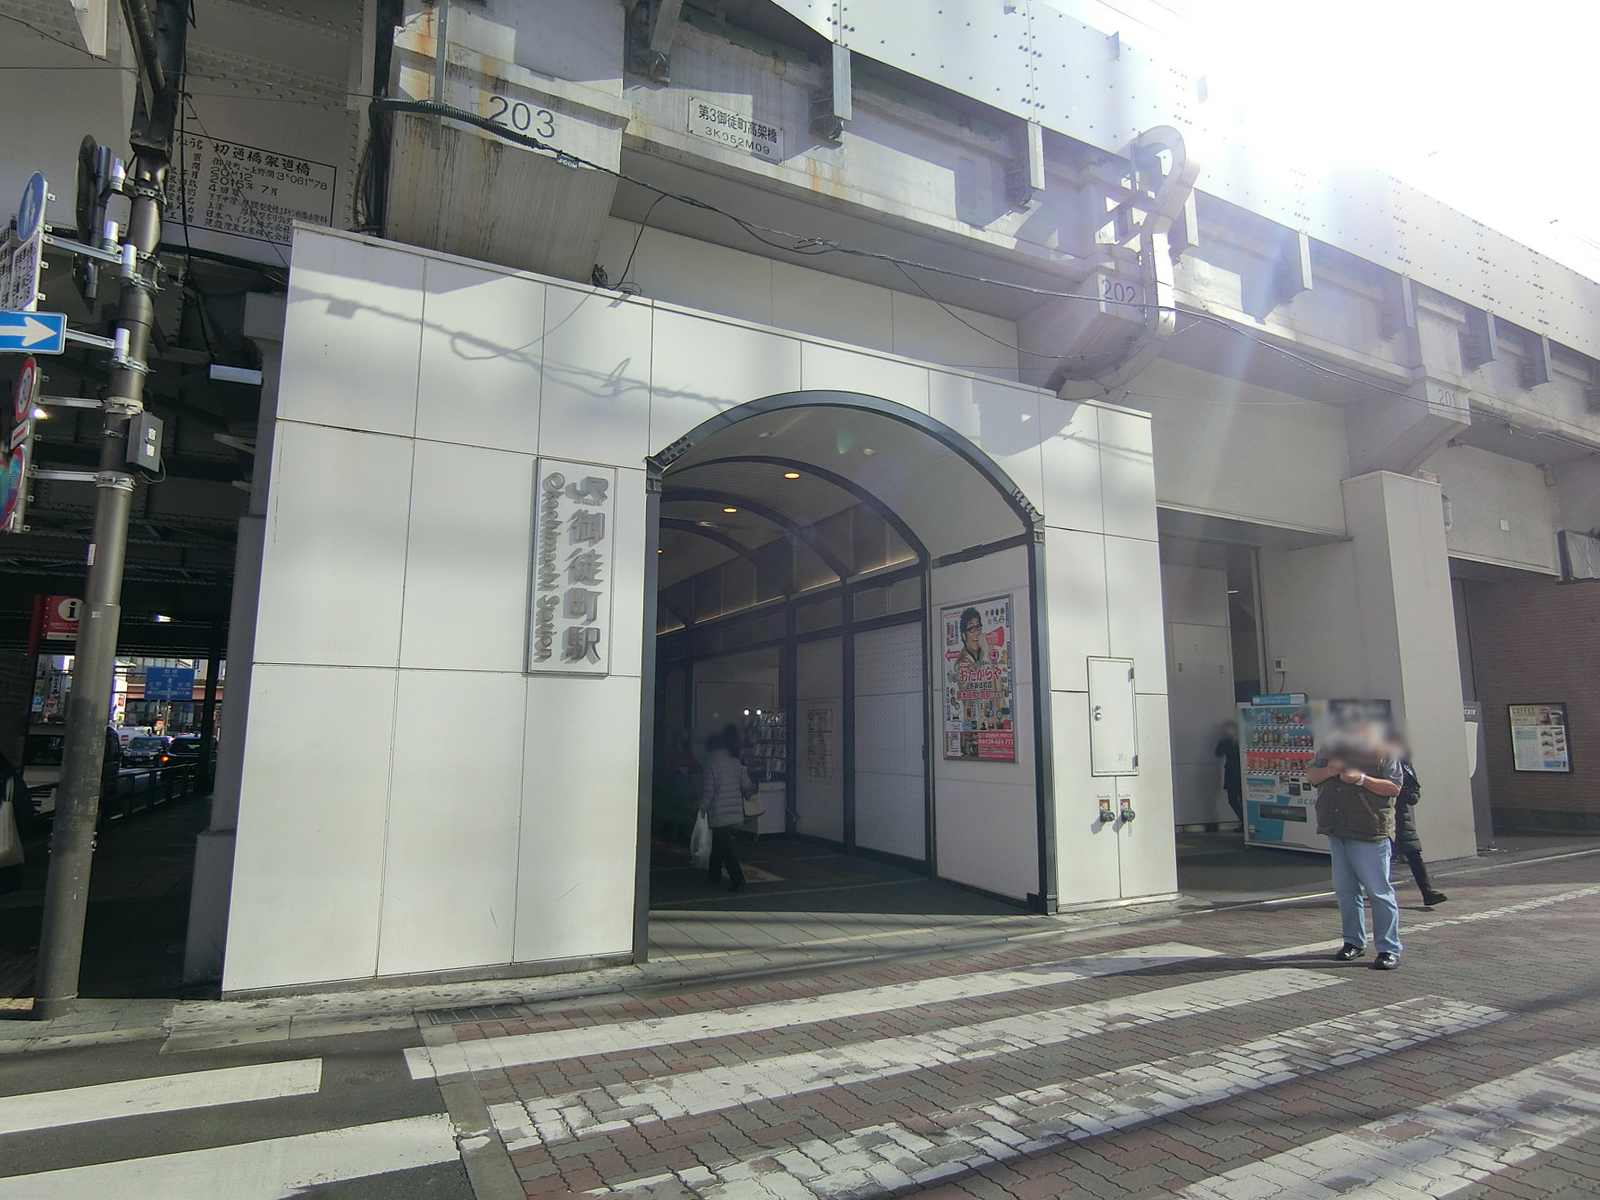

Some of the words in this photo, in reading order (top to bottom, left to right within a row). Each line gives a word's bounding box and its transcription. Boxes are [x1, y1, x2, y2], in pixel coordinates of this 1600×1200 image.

[489, 96, 555, 138] 203
[698, 104, 777, 144] 第3御徒町高架橋
[704, 126, 770, 155] 3K052M09
[1101, 279, 1136, 304] 202
[1437, 388, 1456, 408] 201
[538, 472, 565, 591] Okachimachi
[535, 594, 561, 663] Station
[959, 667, 1003, 683] おたからや
